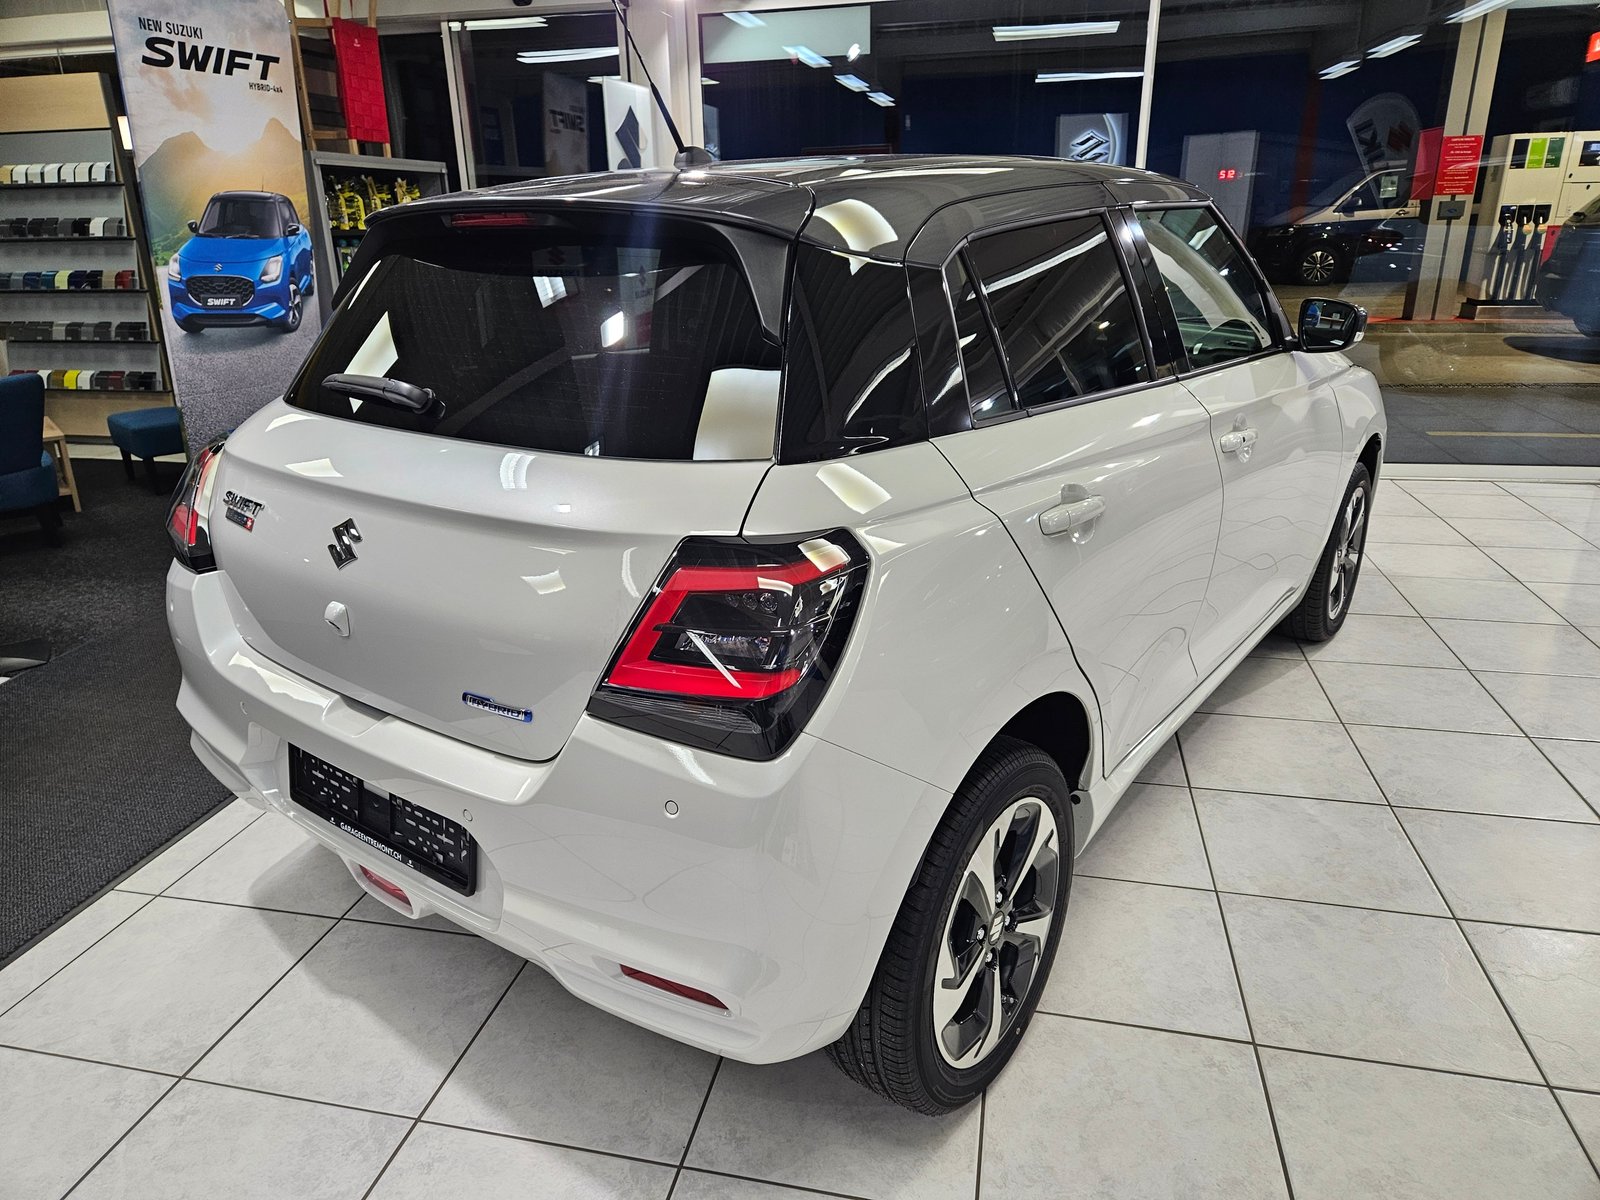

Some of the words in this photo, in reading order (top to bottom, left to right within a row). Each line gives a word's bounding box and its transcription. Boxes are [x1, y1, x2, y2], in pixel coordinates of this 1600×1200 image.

[138, 17, 162, 33] NEW
[166, 22, 203, 40] SUZUKI
[141, 36, 280, 81] SWIFT
[207, 298, 236, 306] SWIFT
[223, 490, 263, 515] SWIFT
[466, 695, 524, 719] HYBRID
[340, 822, 402, 861] GARAGEENTREMONT.CH
